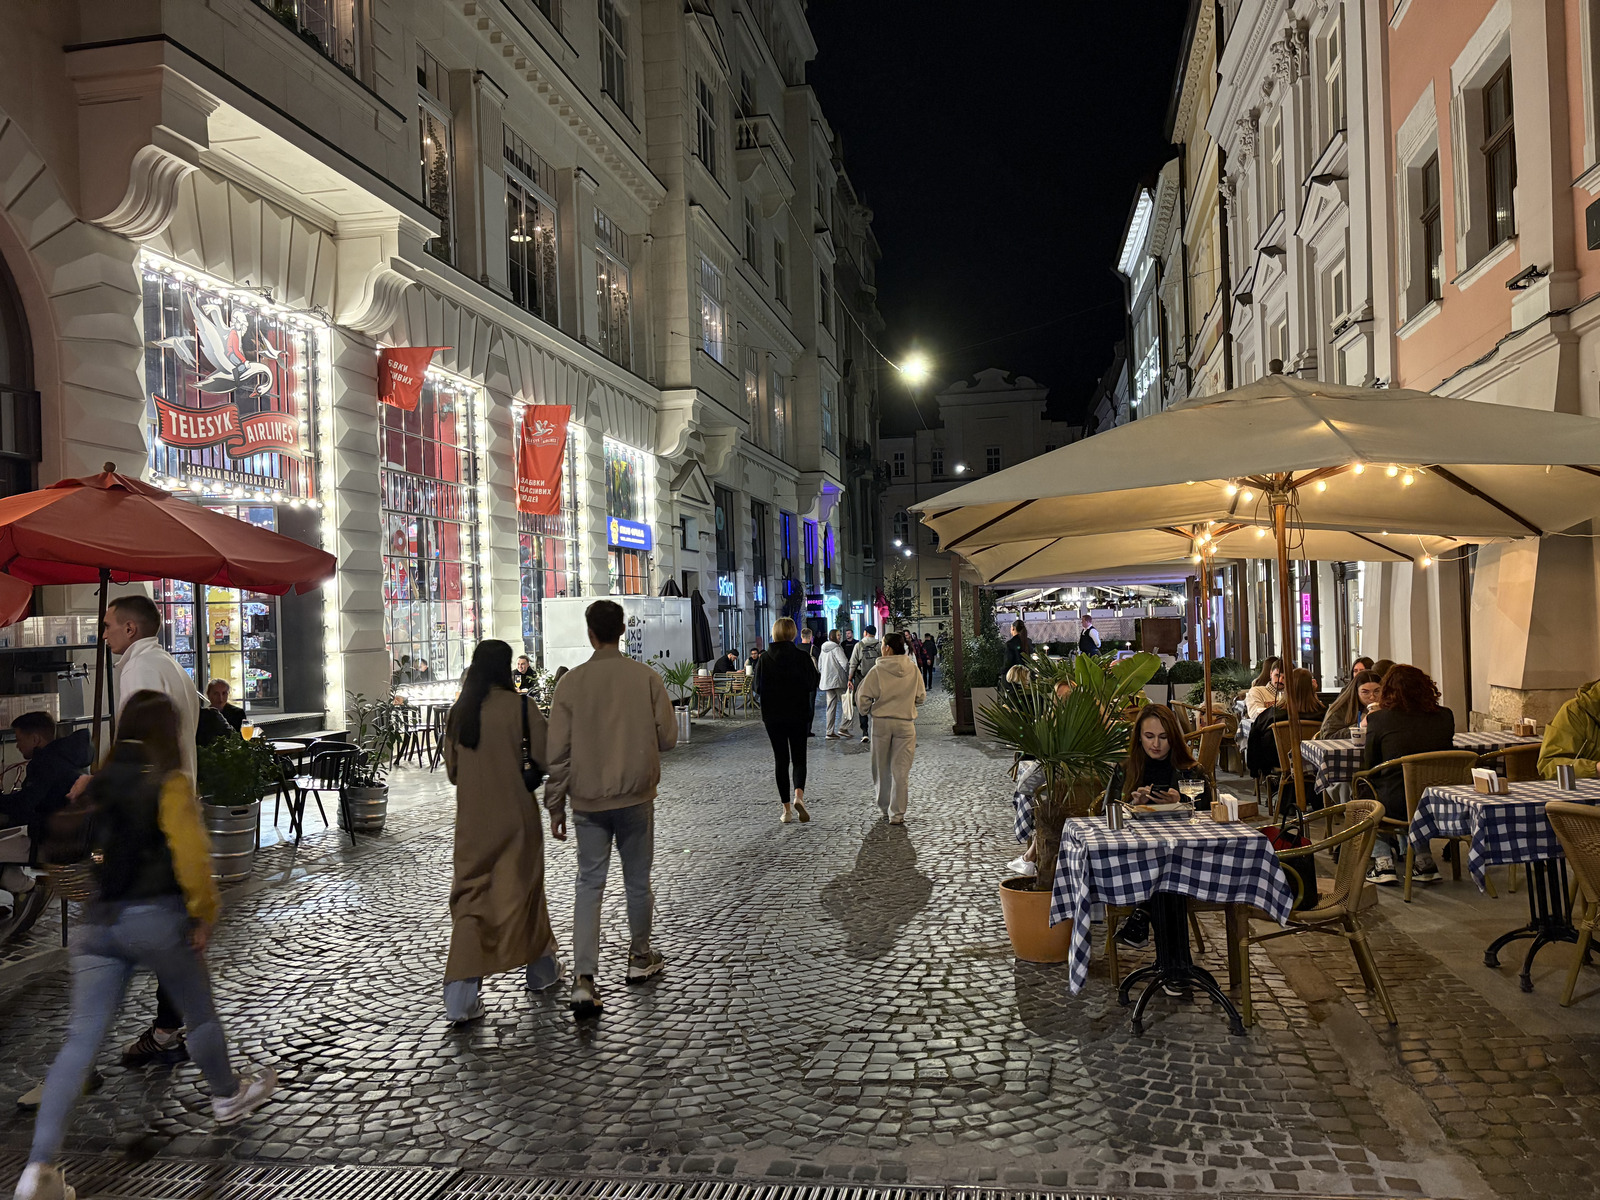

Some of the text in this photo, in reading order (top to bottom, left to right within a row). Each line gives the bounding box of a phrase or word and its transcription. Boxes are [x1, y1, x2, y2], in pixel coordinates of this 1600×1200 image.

[168, 410, 294, 444] TELESYK AIRLINES
[186, 464, 222, 480] ЗАБАВКИ
[223, 470, 263, 486] ЩАСЛИВИХ
[520, 477, 546, 487] ЗАБВКИ
[519, 485, 552, 496] ЩАСИВИХ
